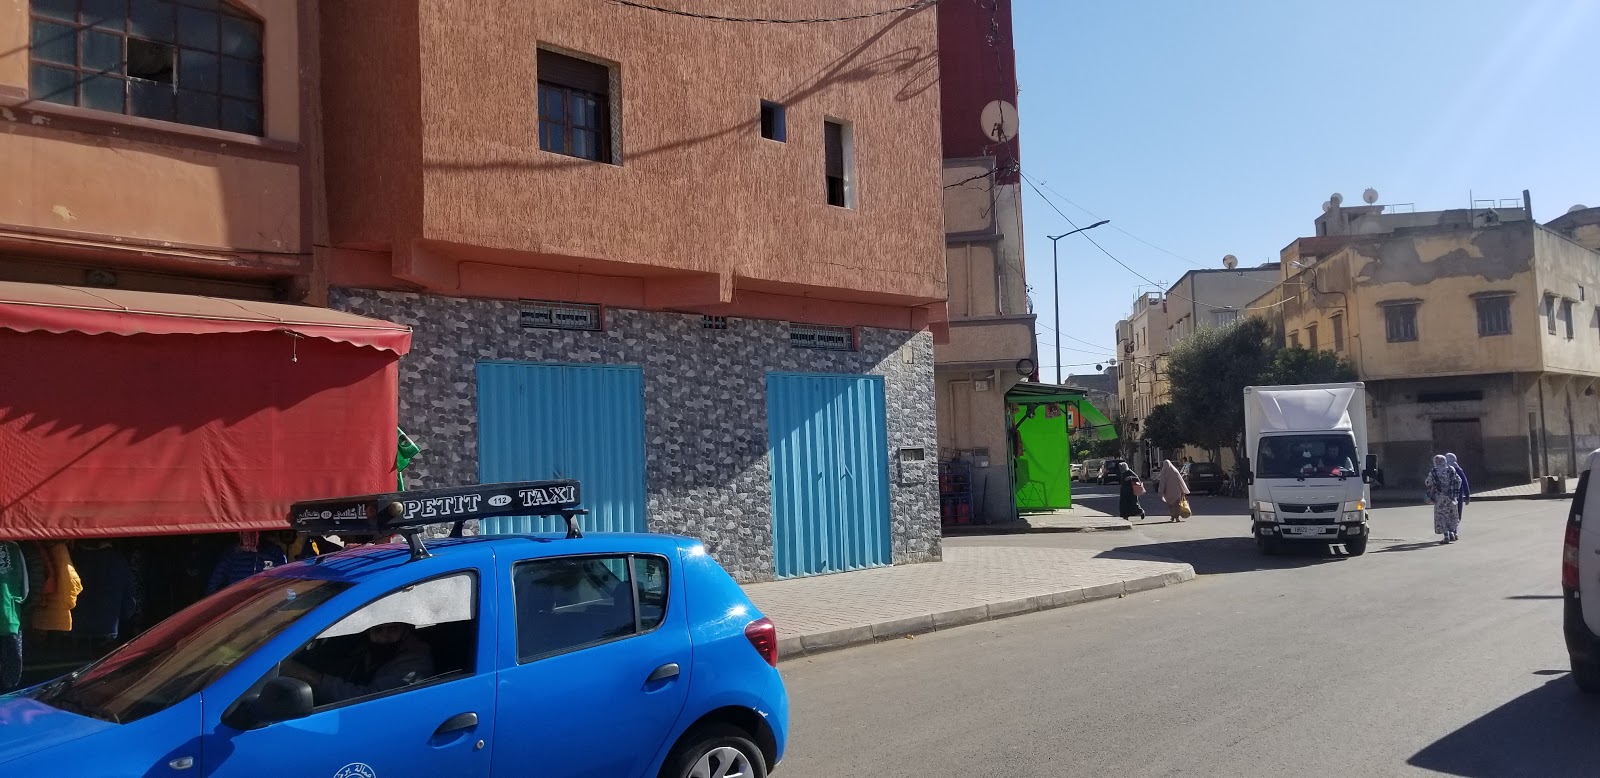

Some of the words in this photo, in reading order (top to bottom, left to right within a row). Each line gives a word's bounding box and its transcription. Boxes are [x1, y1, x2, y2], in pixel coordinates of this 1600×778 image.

[403, 494, 482, 519] PETIT
[493, 496, 508, 505] 112
[519, 485, 576, 507] TAXI
